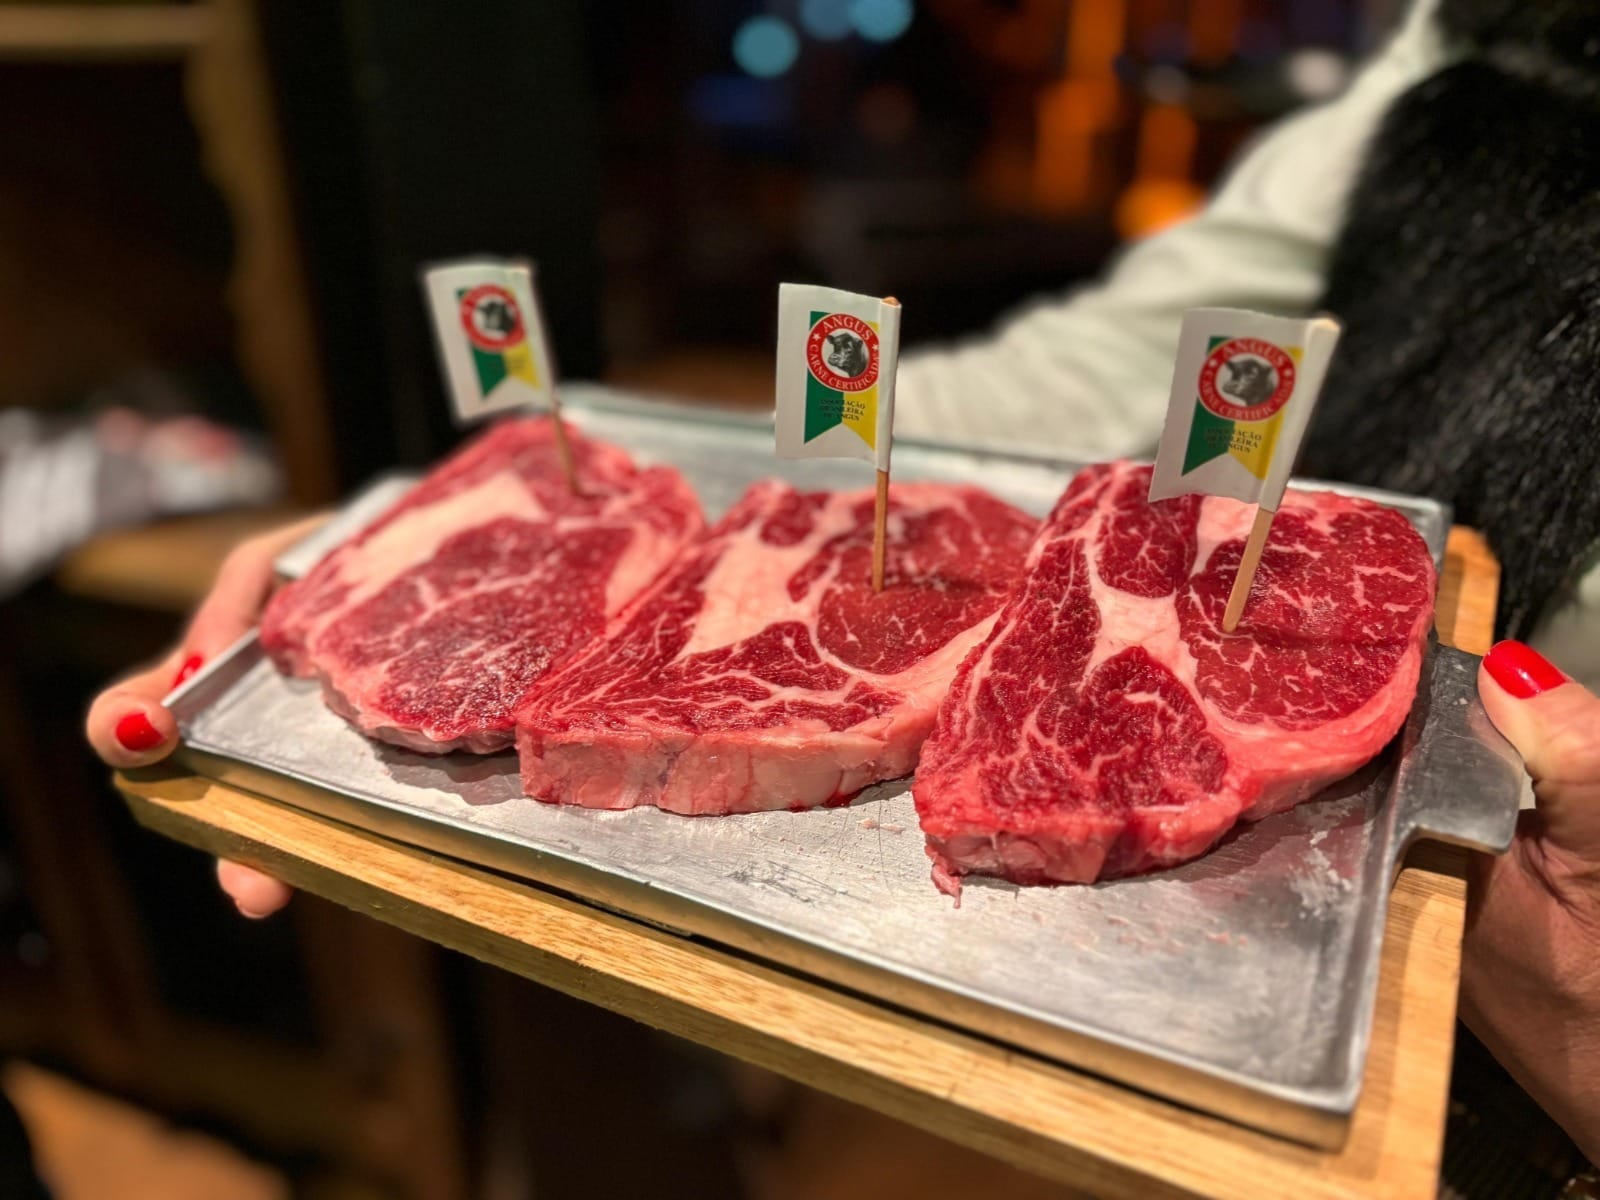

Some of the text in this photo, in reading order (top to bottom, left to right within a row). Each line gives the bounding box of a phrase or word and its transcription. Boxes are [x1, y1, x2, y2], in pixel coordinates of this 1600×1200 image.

[822, 315, 873, 341] ANGUS
[808, 344, 880, 390] CARNE CERTIFICADA
[1223, 340, 1286, 367] ANGUS
